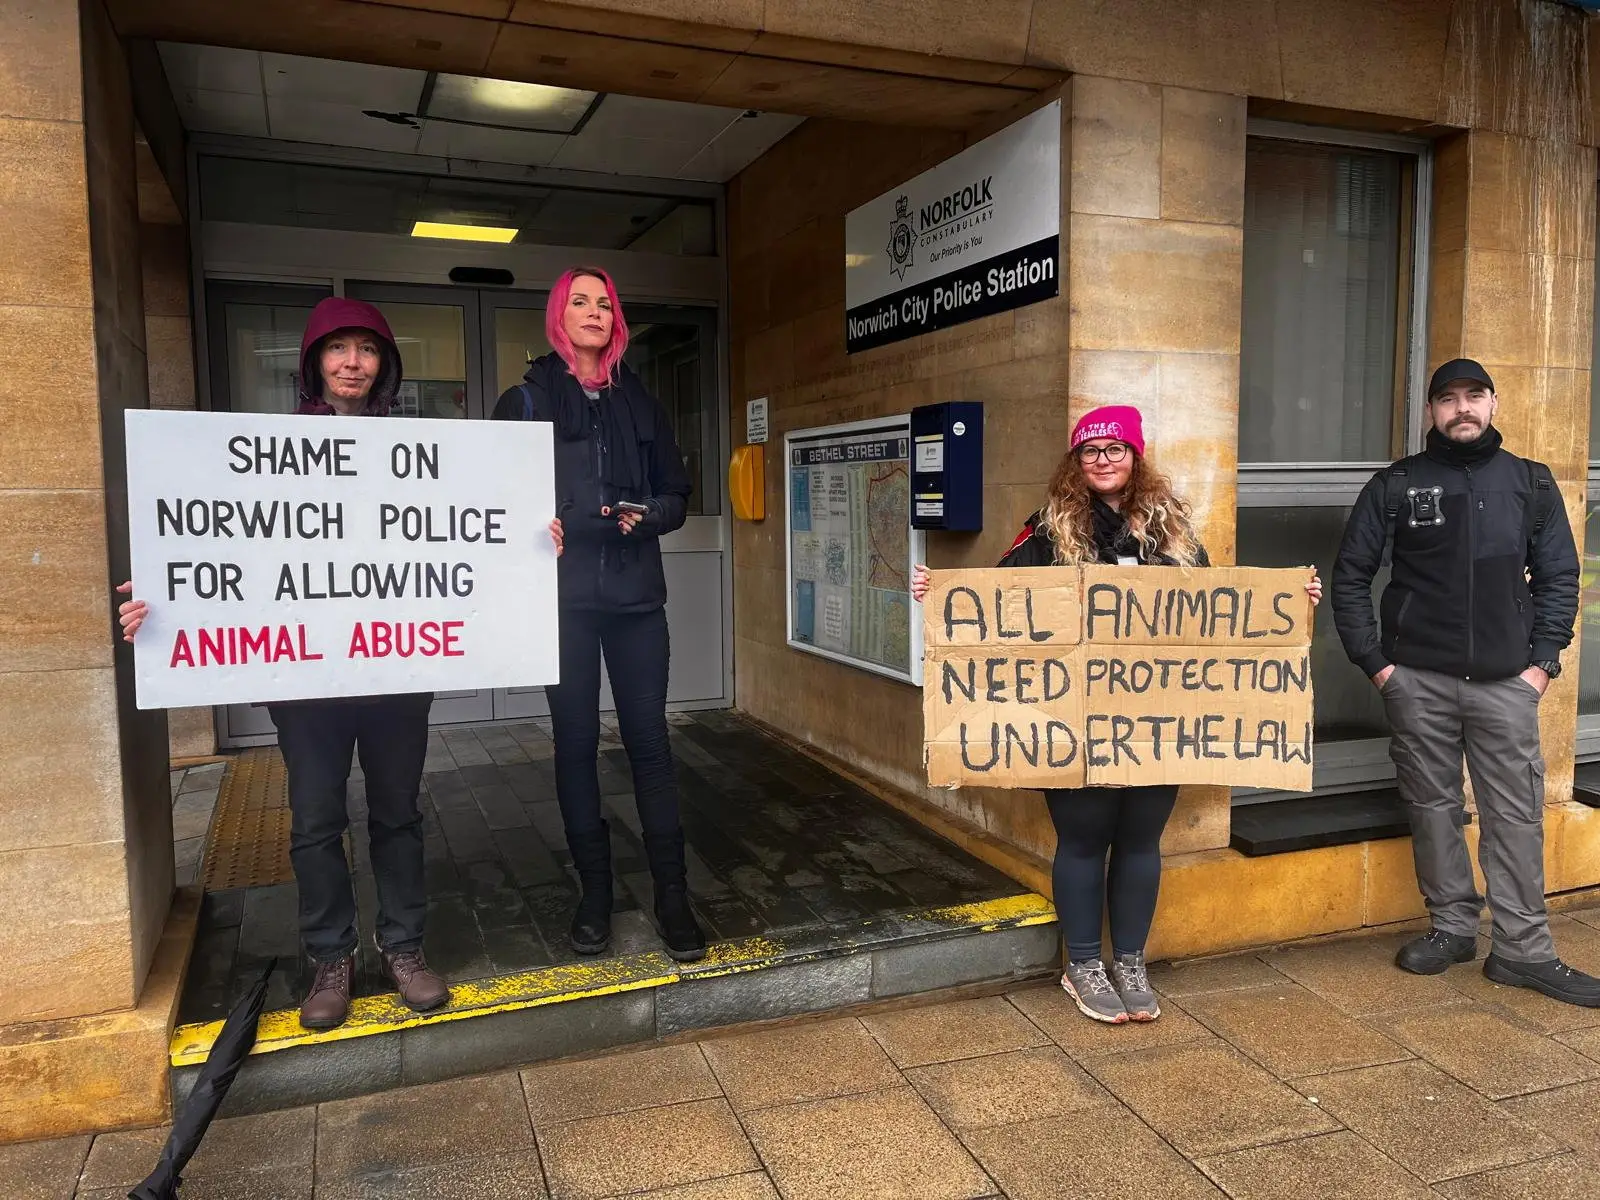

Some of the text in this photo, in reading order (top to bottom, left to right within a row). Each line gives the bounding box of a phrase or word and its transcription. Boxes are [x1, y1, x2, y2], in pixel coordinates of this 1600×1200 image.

[920, 176, 993, 231] NORFOLK
[920, 210, 993, 247] CONSTABULARY
[930, 236, 983, 263] Our Priority is You
[848, 256, 1054, 341] Norwich City Police Station
[228, 435, 439, 480] SHAME ON
[809, 442, 888, 462] BETHEL STREET
[156, 498, 507, 544] NORWICH POLICE
[167, 561, 474, 602] FOR ALLOWING
[944, 583, 1294, 643] ALL ANIMALS
[169, 621, 465, 668] ANIMAL ABUSE
[941, 657, 1308, 705] NEED PROTECTION
